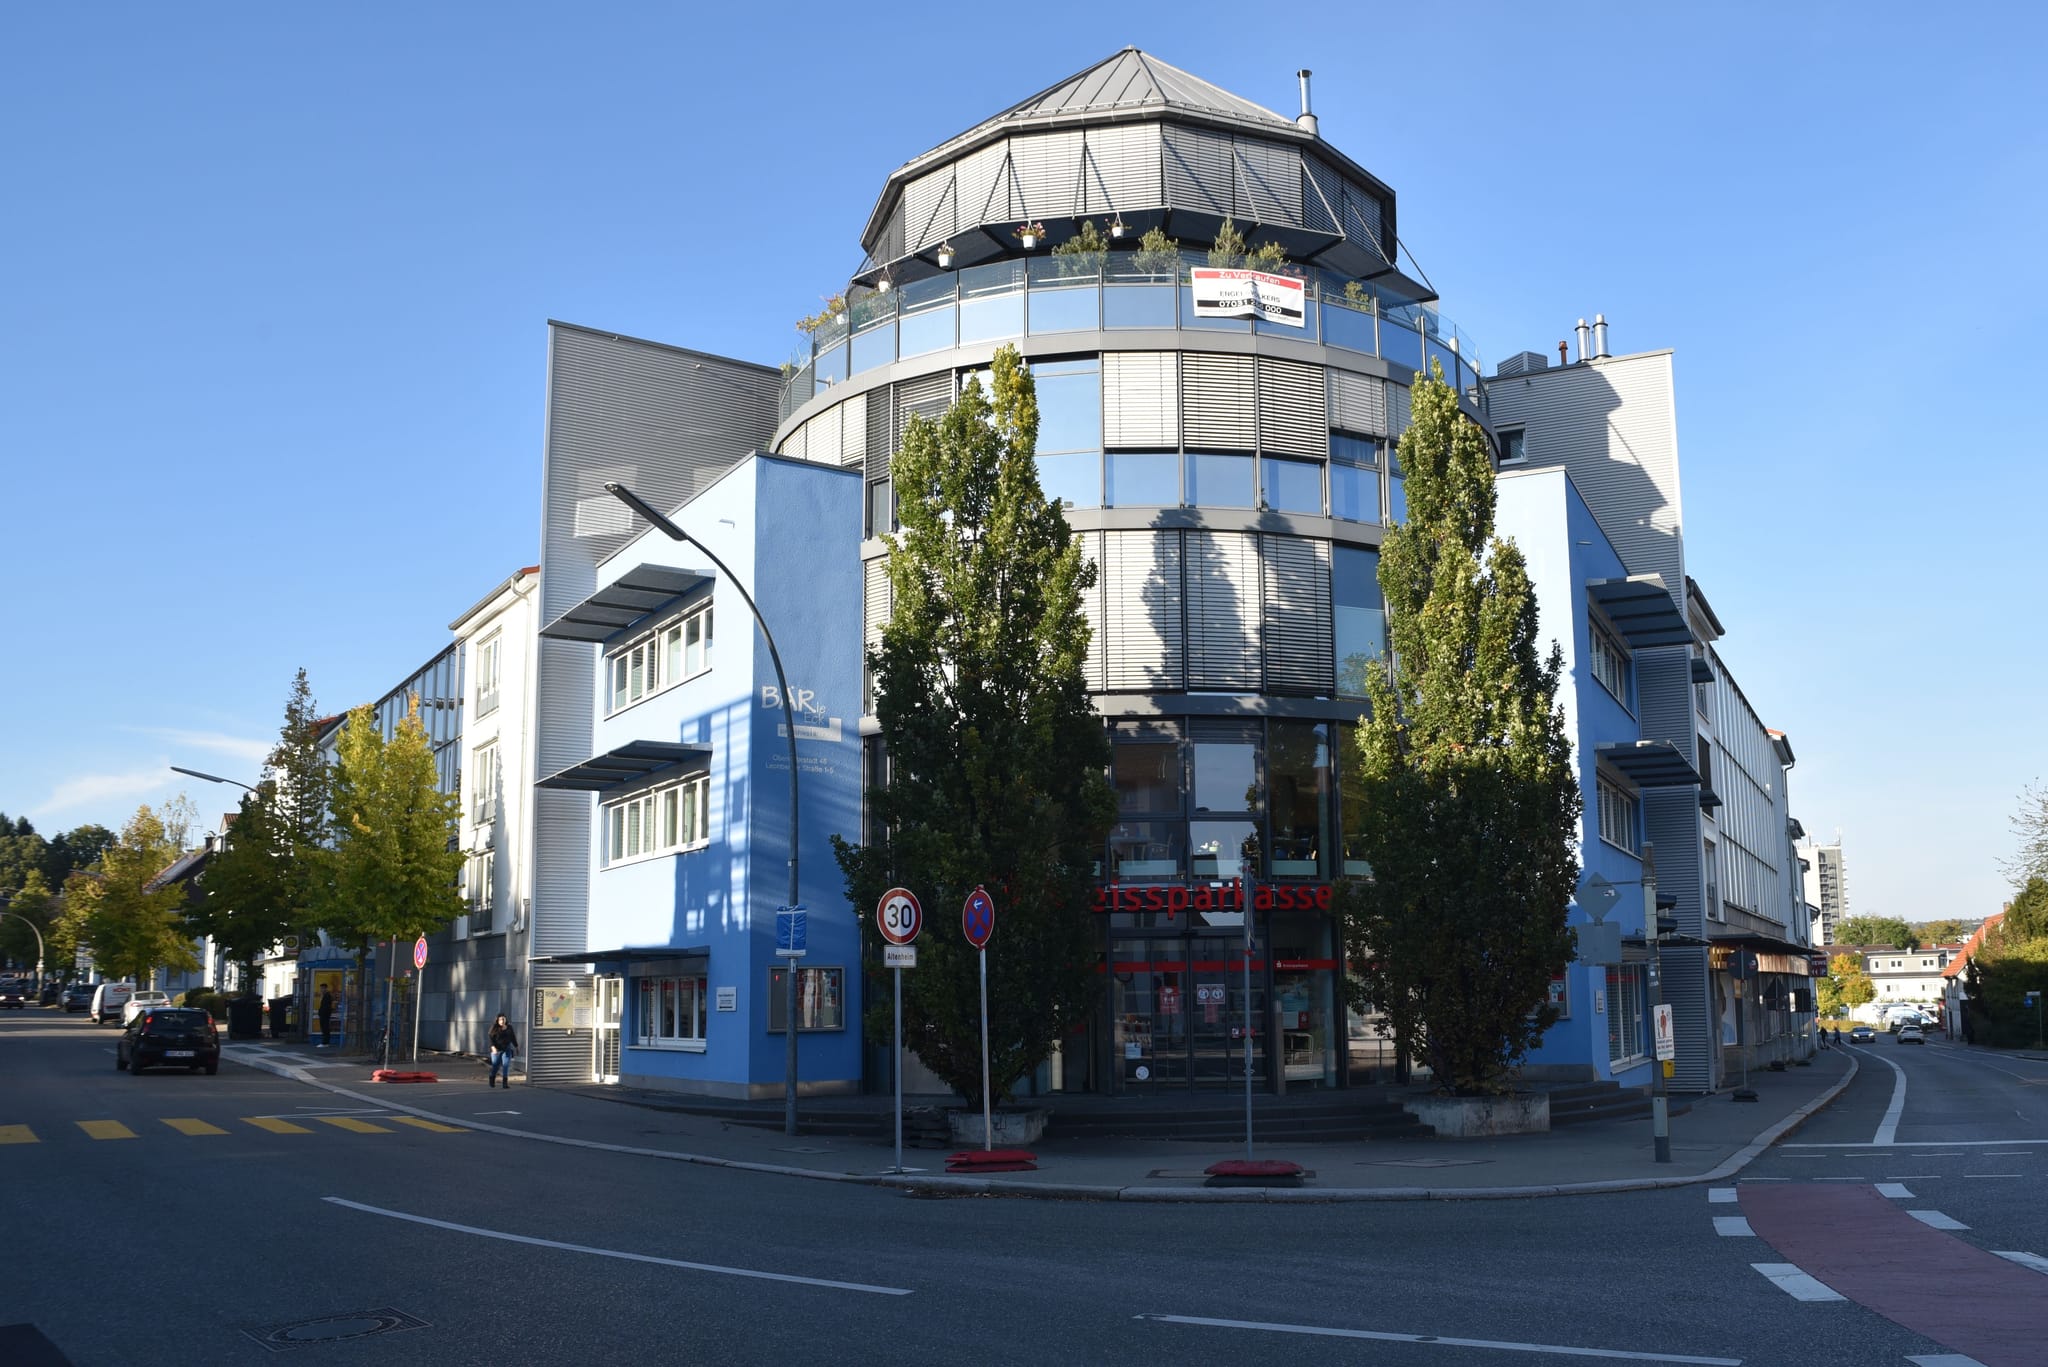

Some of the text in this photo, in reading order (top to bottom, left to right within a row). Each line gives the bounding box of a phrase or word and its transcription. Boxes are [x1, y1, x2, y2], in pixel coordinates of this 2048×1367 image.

[1265, 305, 1282, 314] 000
[887, 904, 912, 928] 30
[887, 952, 914, 960] Altenheim
